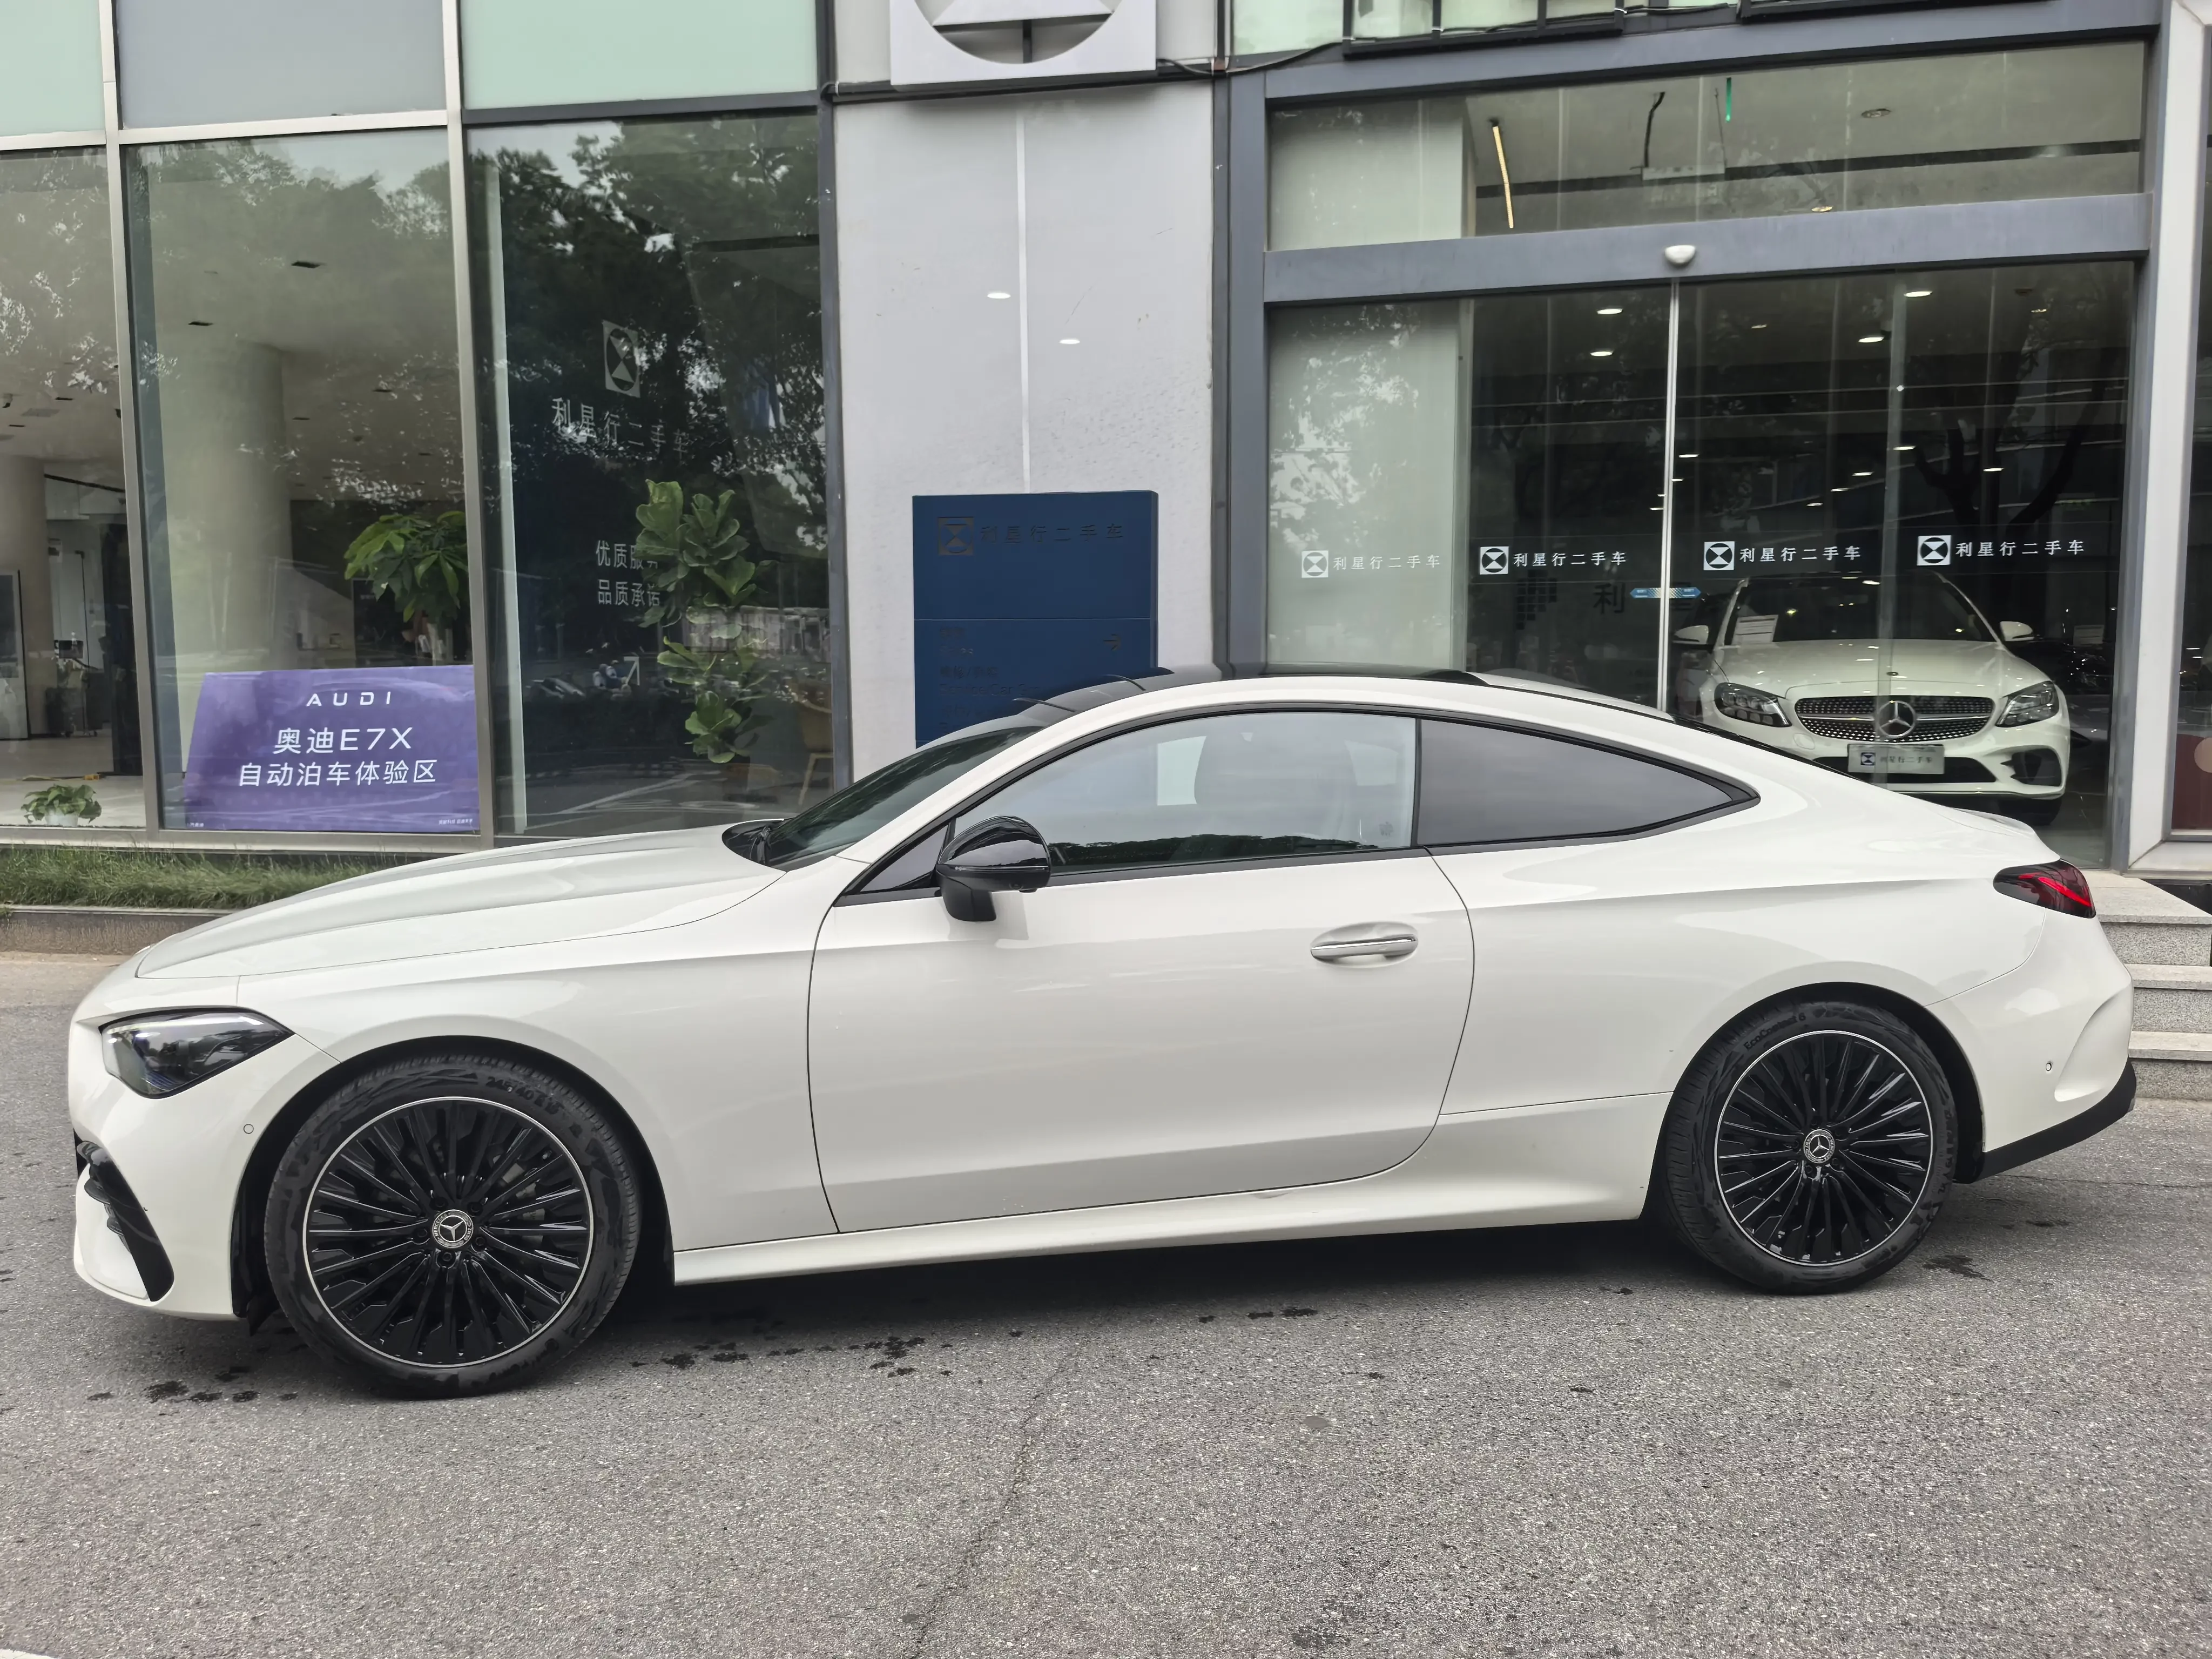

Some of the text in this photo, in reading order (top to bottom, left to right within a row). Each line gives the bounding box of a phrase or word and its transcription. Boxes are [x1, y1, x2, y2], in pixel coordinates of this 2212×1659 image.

[551, 397, 690, 461] 利星行二手车
[1739, 544, 1862, 563] 利星行二手车
[1955, 538, 2085, 557] 利星行二手车
[1333, 554, 1441, 571] 利星行二手车
[1513, 550, 1628, 568] 利星行二手车
[598, 578, 661, 607] 品质承诺
[306, 692, 392, 707] AUDI
[273, 726, 414, 756] 奥迪E7X
[239, 759, 438, 788] 自动泊车体验区
